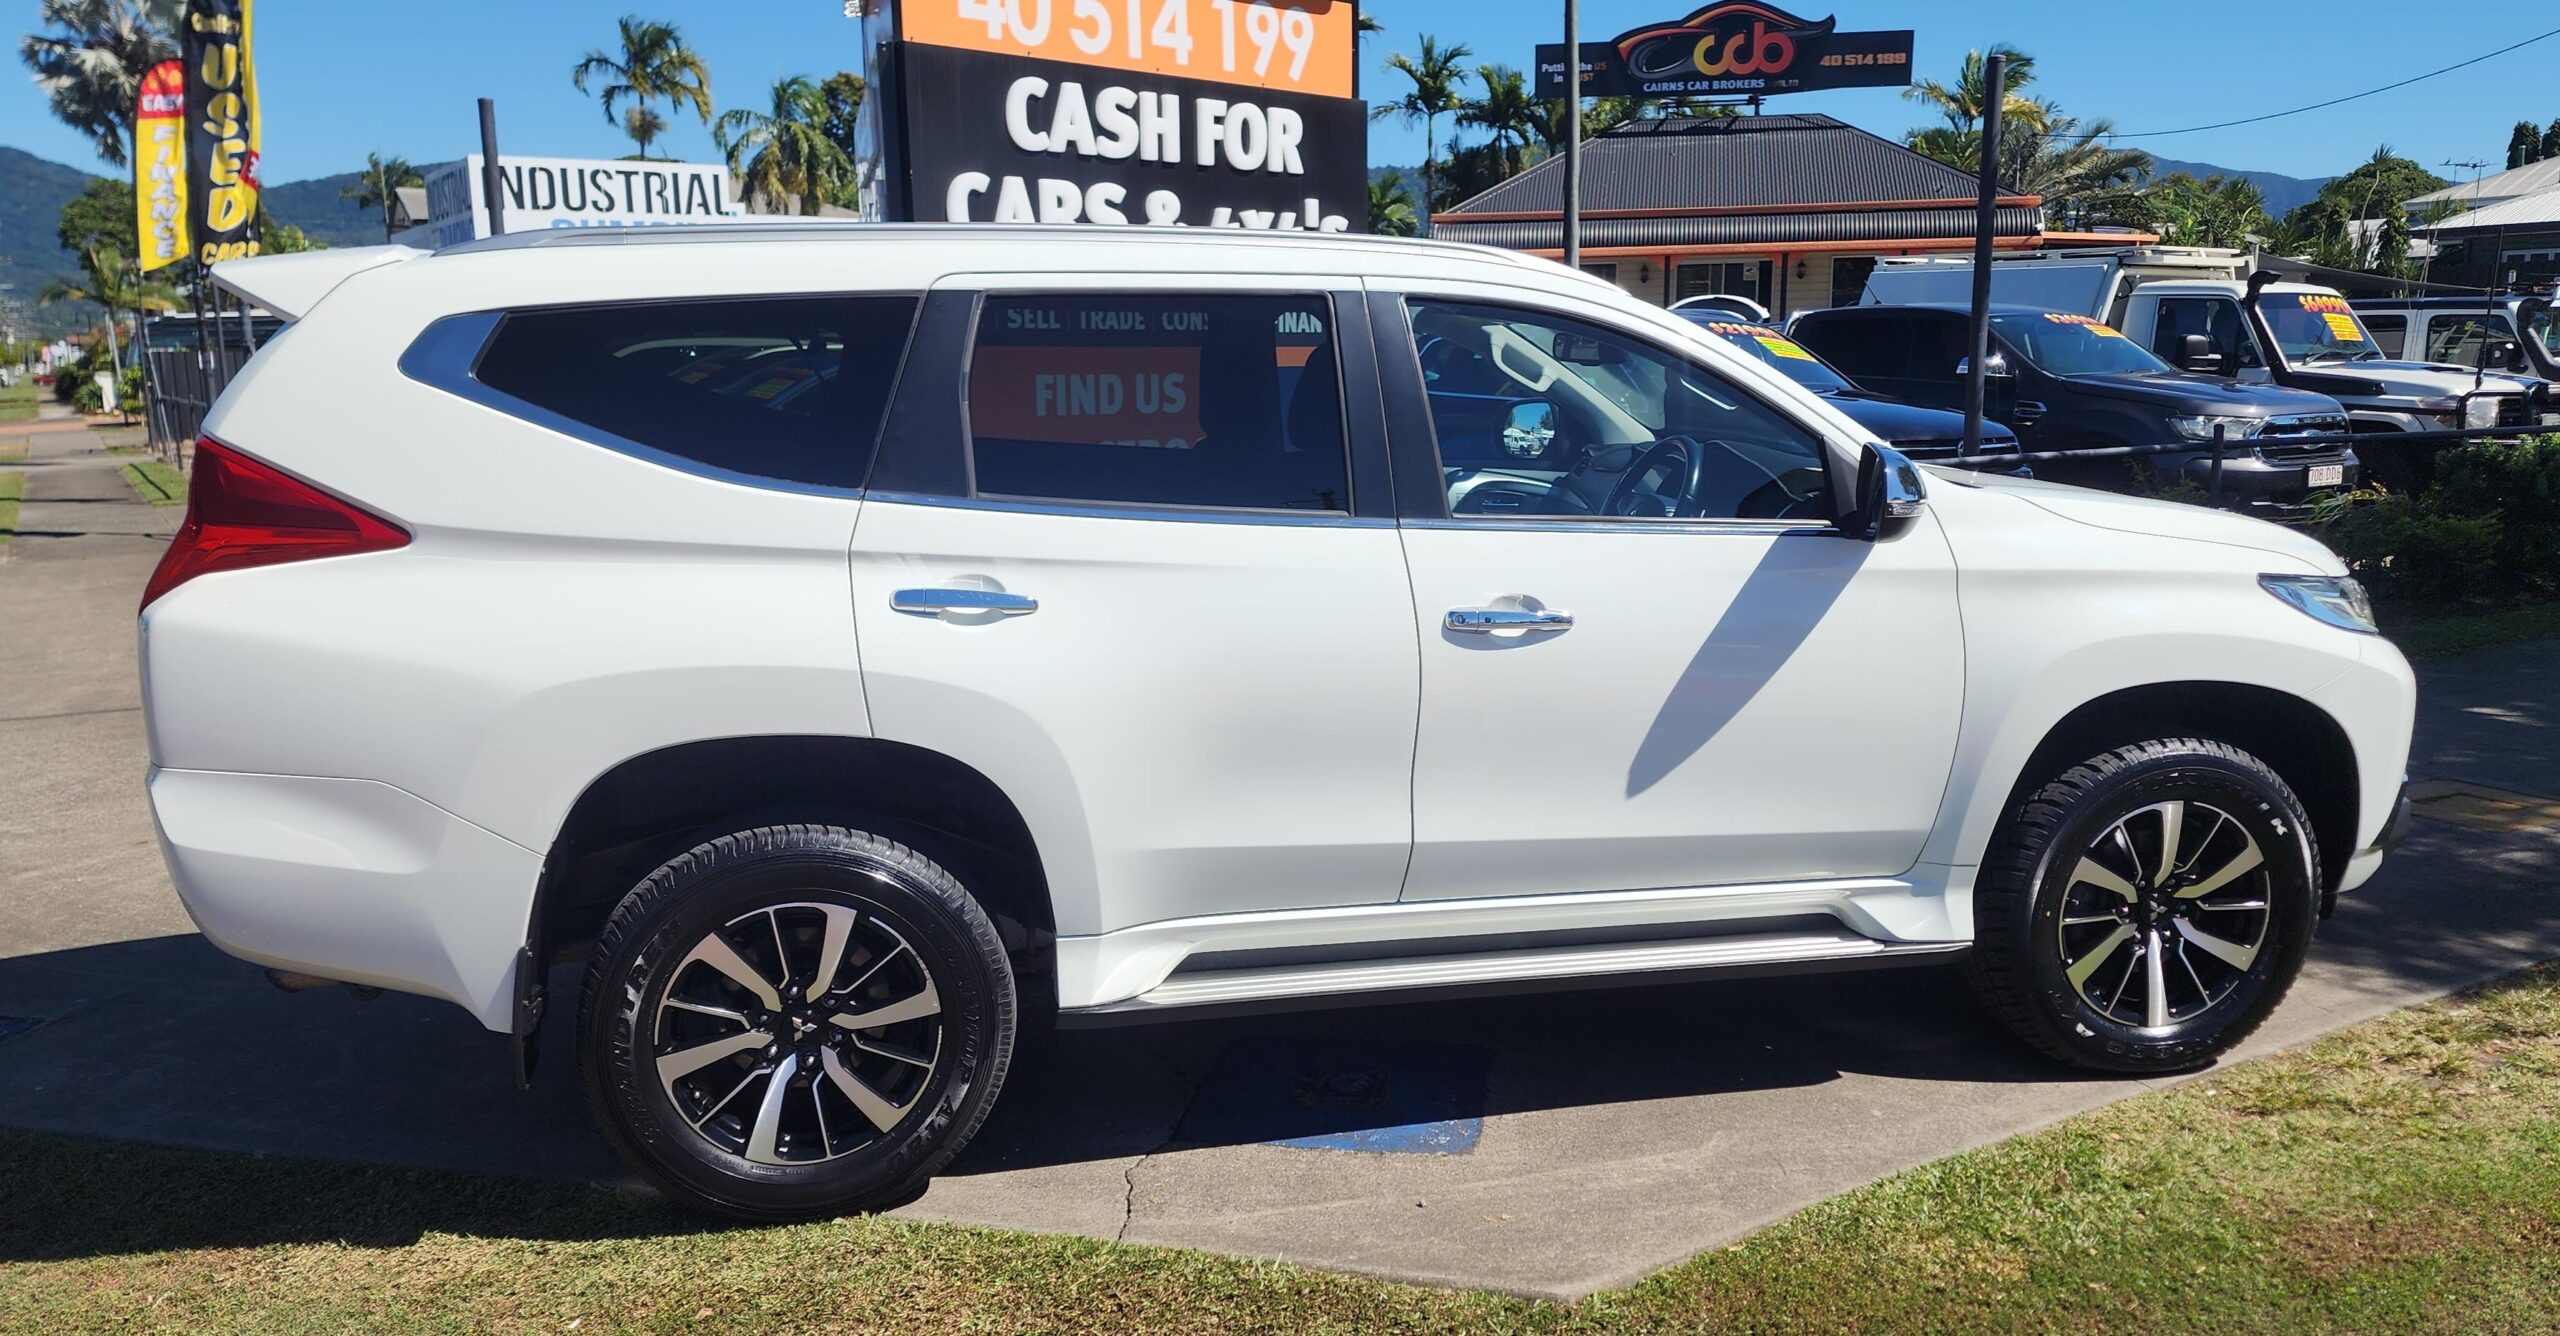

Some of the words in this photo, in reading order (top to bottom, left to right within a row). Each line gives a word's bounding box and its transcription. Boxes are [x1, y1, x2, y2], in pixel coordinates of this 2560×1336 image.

[957, 0, 1051, 46] 40
[1070, 0, 1193, 66] 514
[1212, 0, 1314, 82] 199
[1820, 54, 1842, 67] 40
[1844, 53, 1874, 66] 514
[1541, 62, 1565, 73] Putti
[1643, 81, 1685, 92] CAIRNS
[1687, 80, 1710, 91] CAR
[1712, 79, 1765, 90] BROKERS
[202, 42, 247, 232] USED
[1005, 76, 1181, 163] CASH
[1196, 97, 1305, 174] FOR
[150, 124, 179, 258] FINANCE
[1007, 309, 1062, 330] SELL
[1079, 310, 1147, 331] TRADE
[1035, 373, 1125, 417] FIND
[1136, 372, 1187, 414] US
